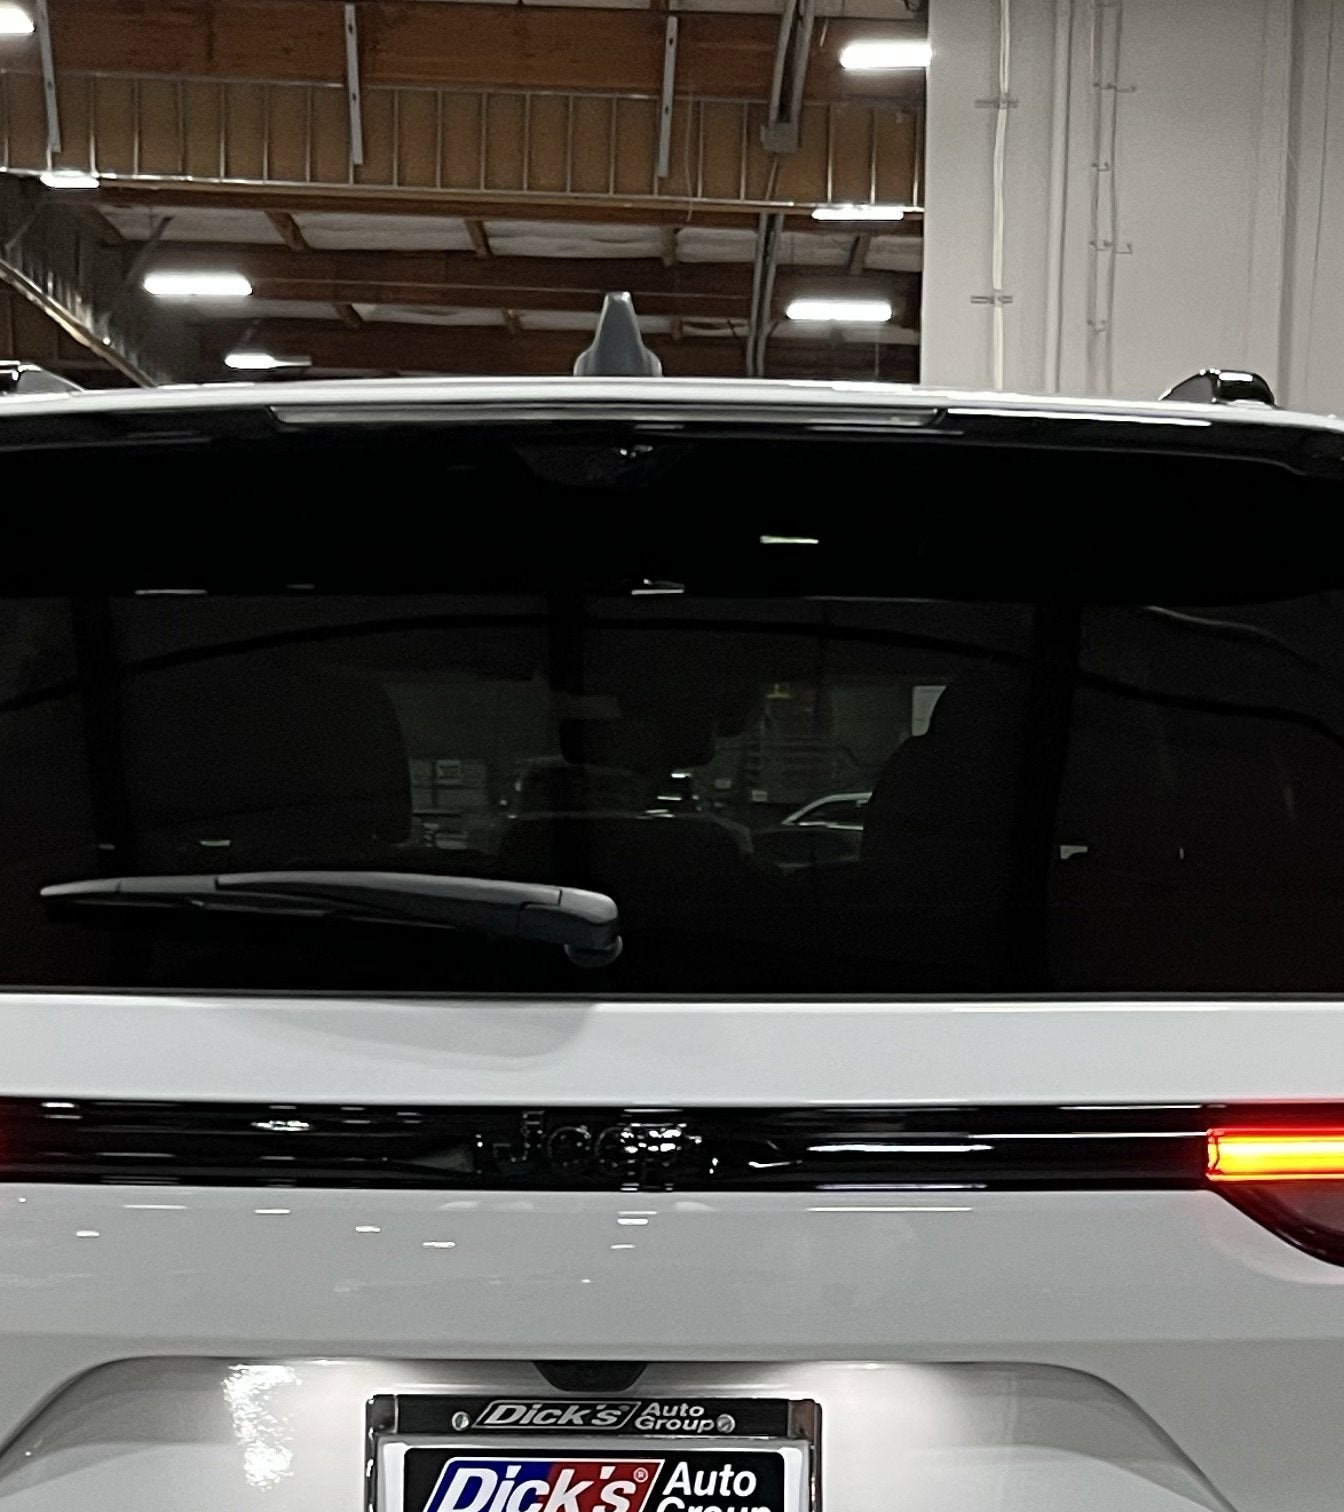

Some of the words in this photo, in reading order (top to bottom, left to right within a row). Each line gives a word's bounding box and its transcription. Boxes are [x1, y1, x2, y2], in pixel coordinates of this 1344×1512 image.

[640, 1401, 706, 1418] Auto
[634, 1415, 715, 1434] Group
[662, 1461, 757, 1497] Auto
